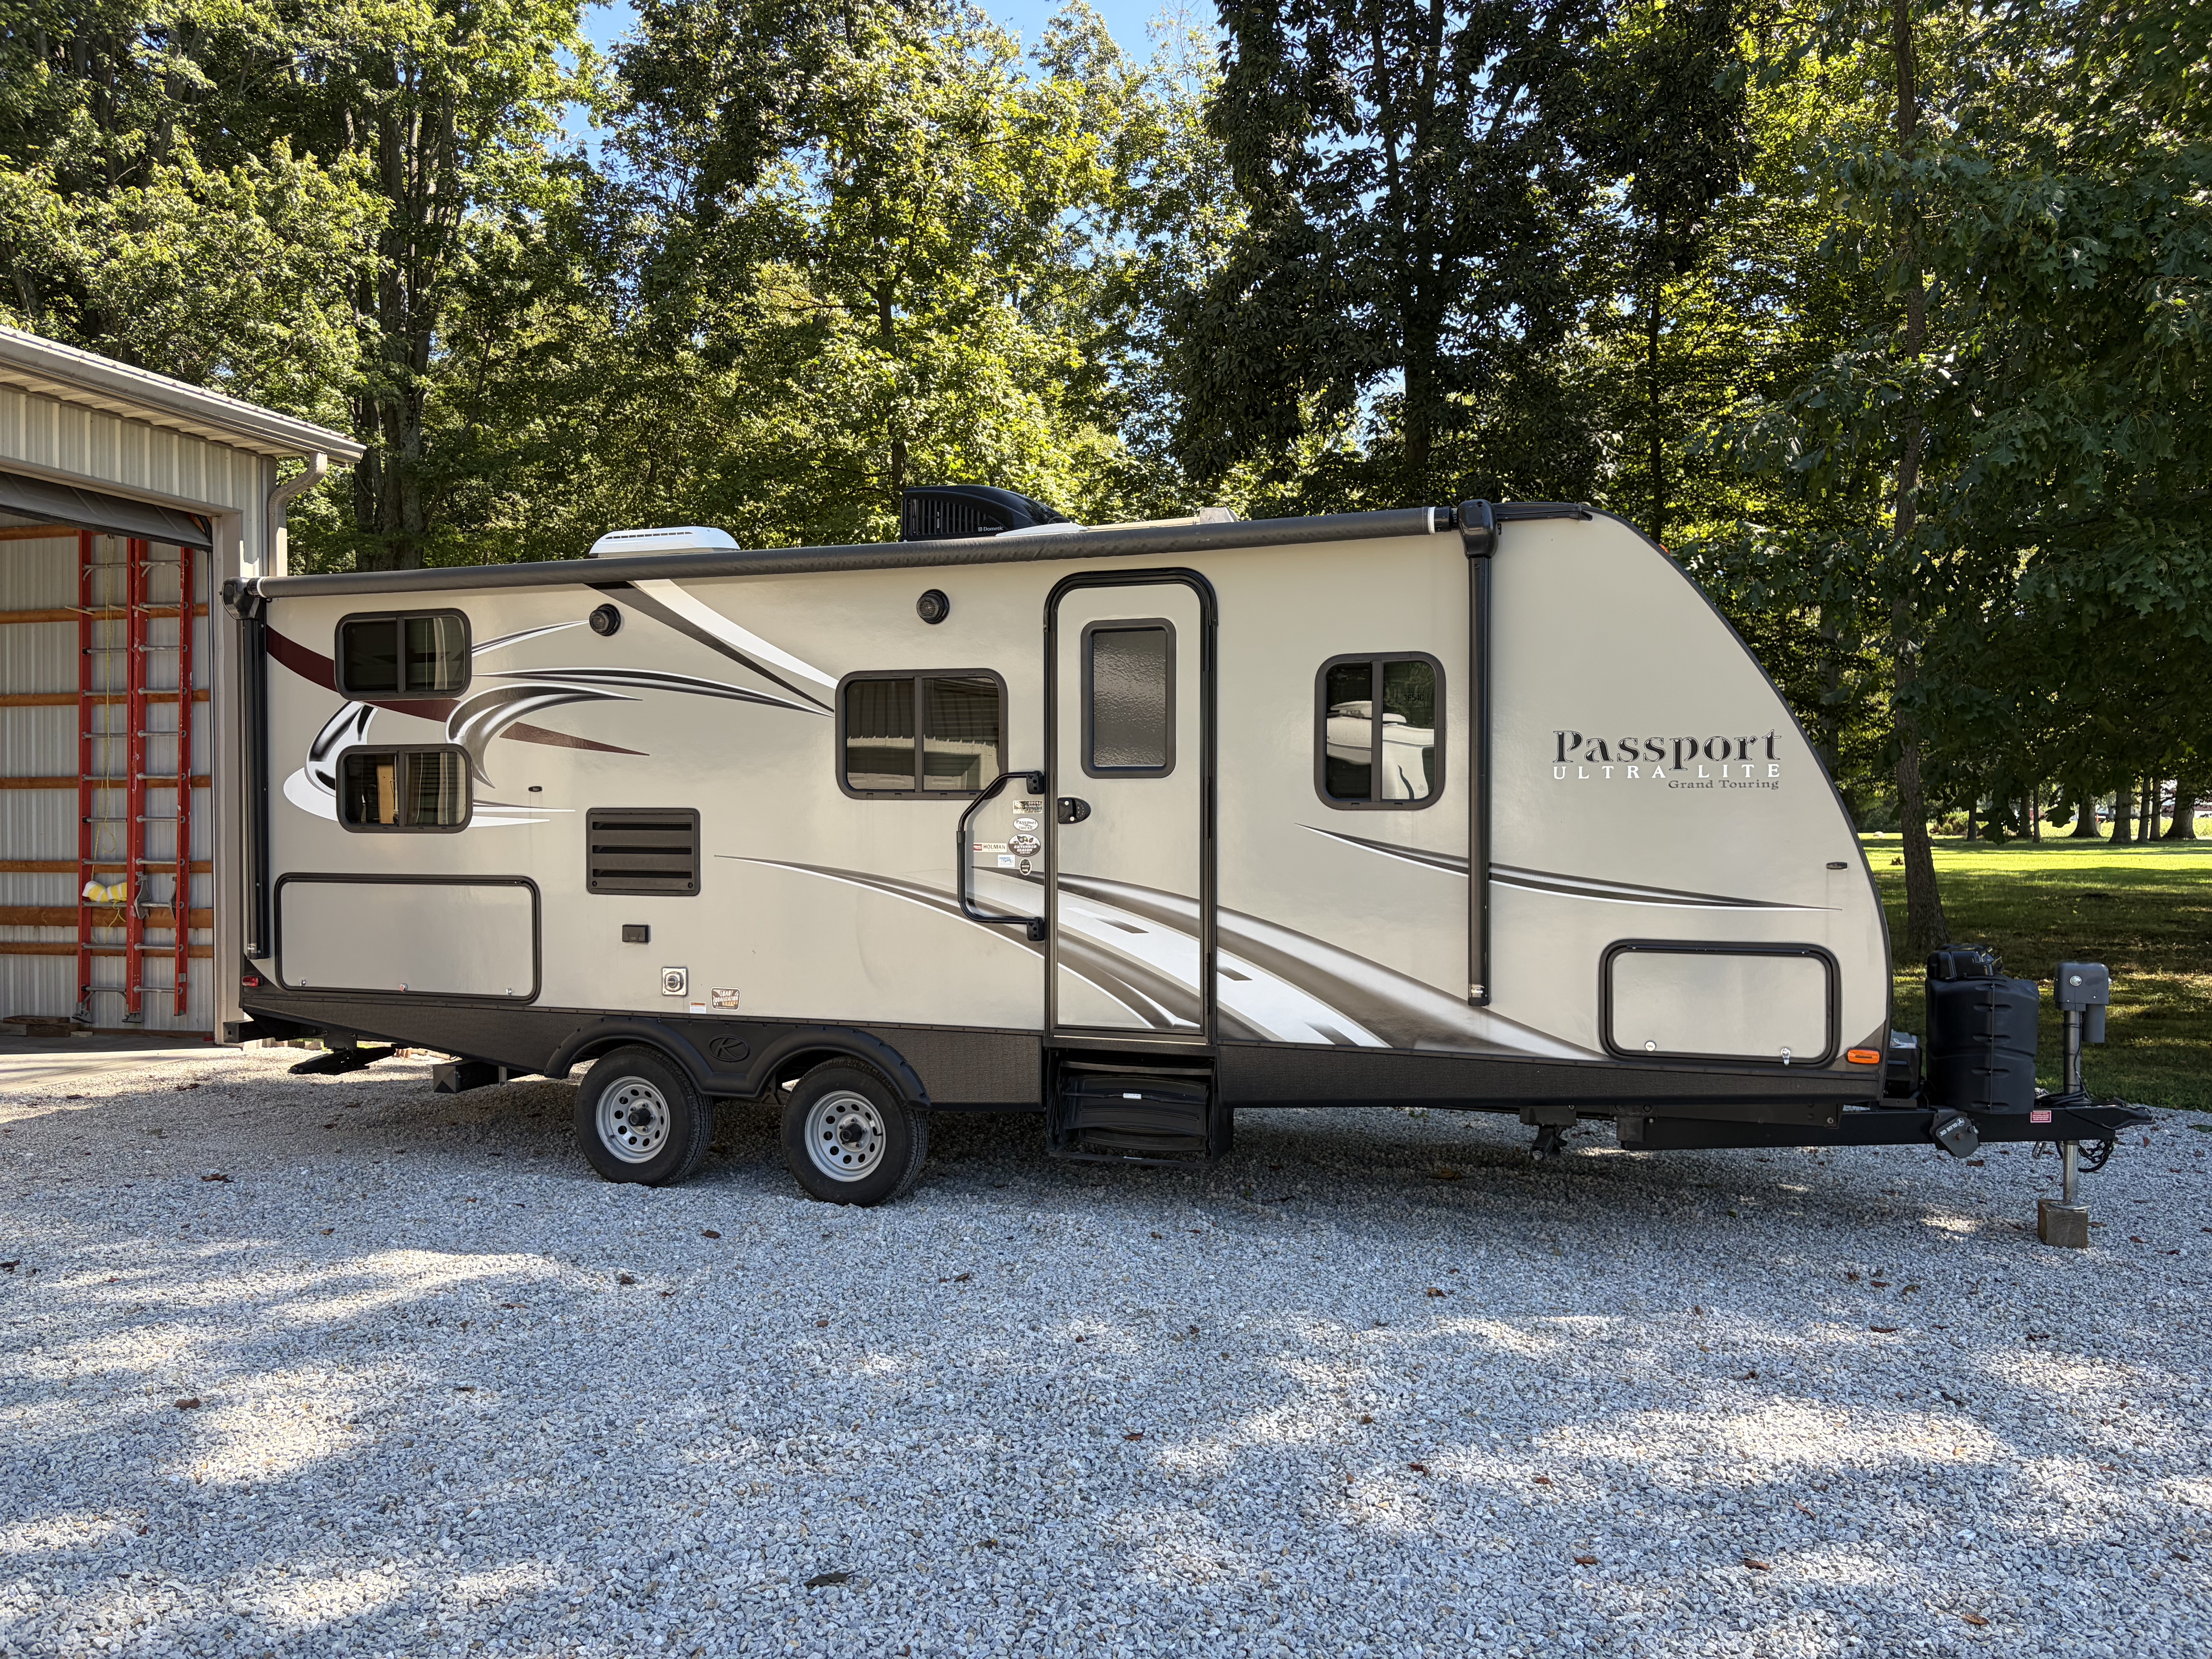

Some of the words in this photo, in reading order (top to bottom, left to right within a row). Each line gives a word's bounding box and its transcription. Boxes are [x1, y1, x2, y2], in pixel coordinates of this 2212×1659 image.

[1552, 729, 1781, 771] Passport
[1553, 765, 1666, 780] ULTRA
[1698, 764, 1780, 778] LITE
[1668, 780, 1714, 789] Grand
[1718, 780, 1779, 790] Touring
[1946, 1122, 1958, 1132] BLUE
